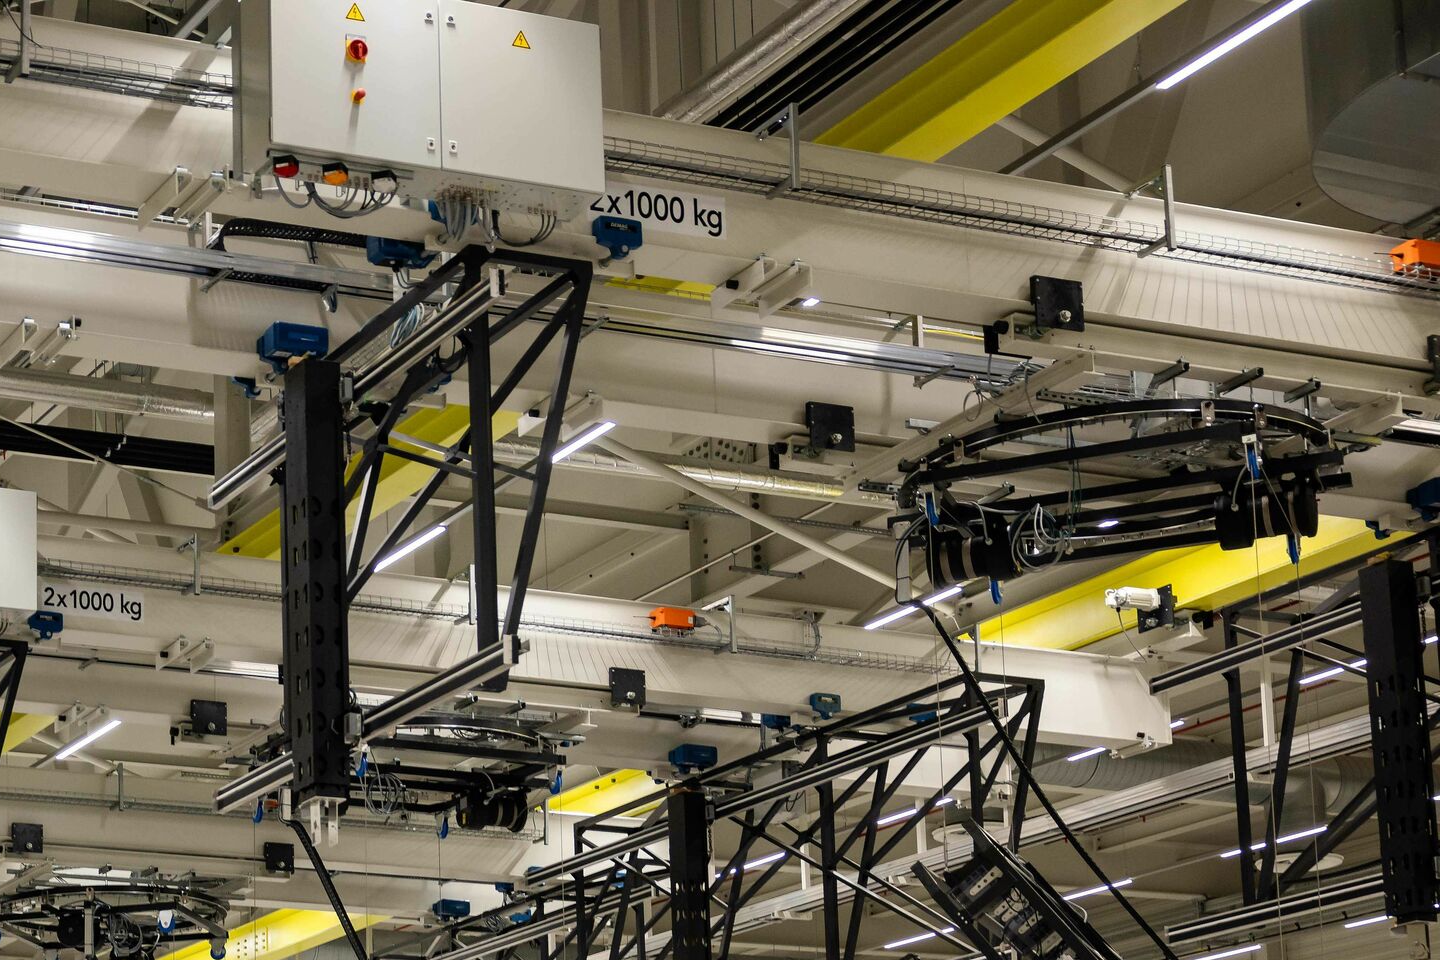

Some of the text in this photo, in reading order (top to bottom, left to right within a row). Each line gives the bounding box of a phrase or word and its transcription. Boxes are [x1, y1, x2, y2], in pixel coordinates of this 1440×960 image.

[693, 198, 723, 237] kg
[43, 586, 142, 621] 2x1000 kg
